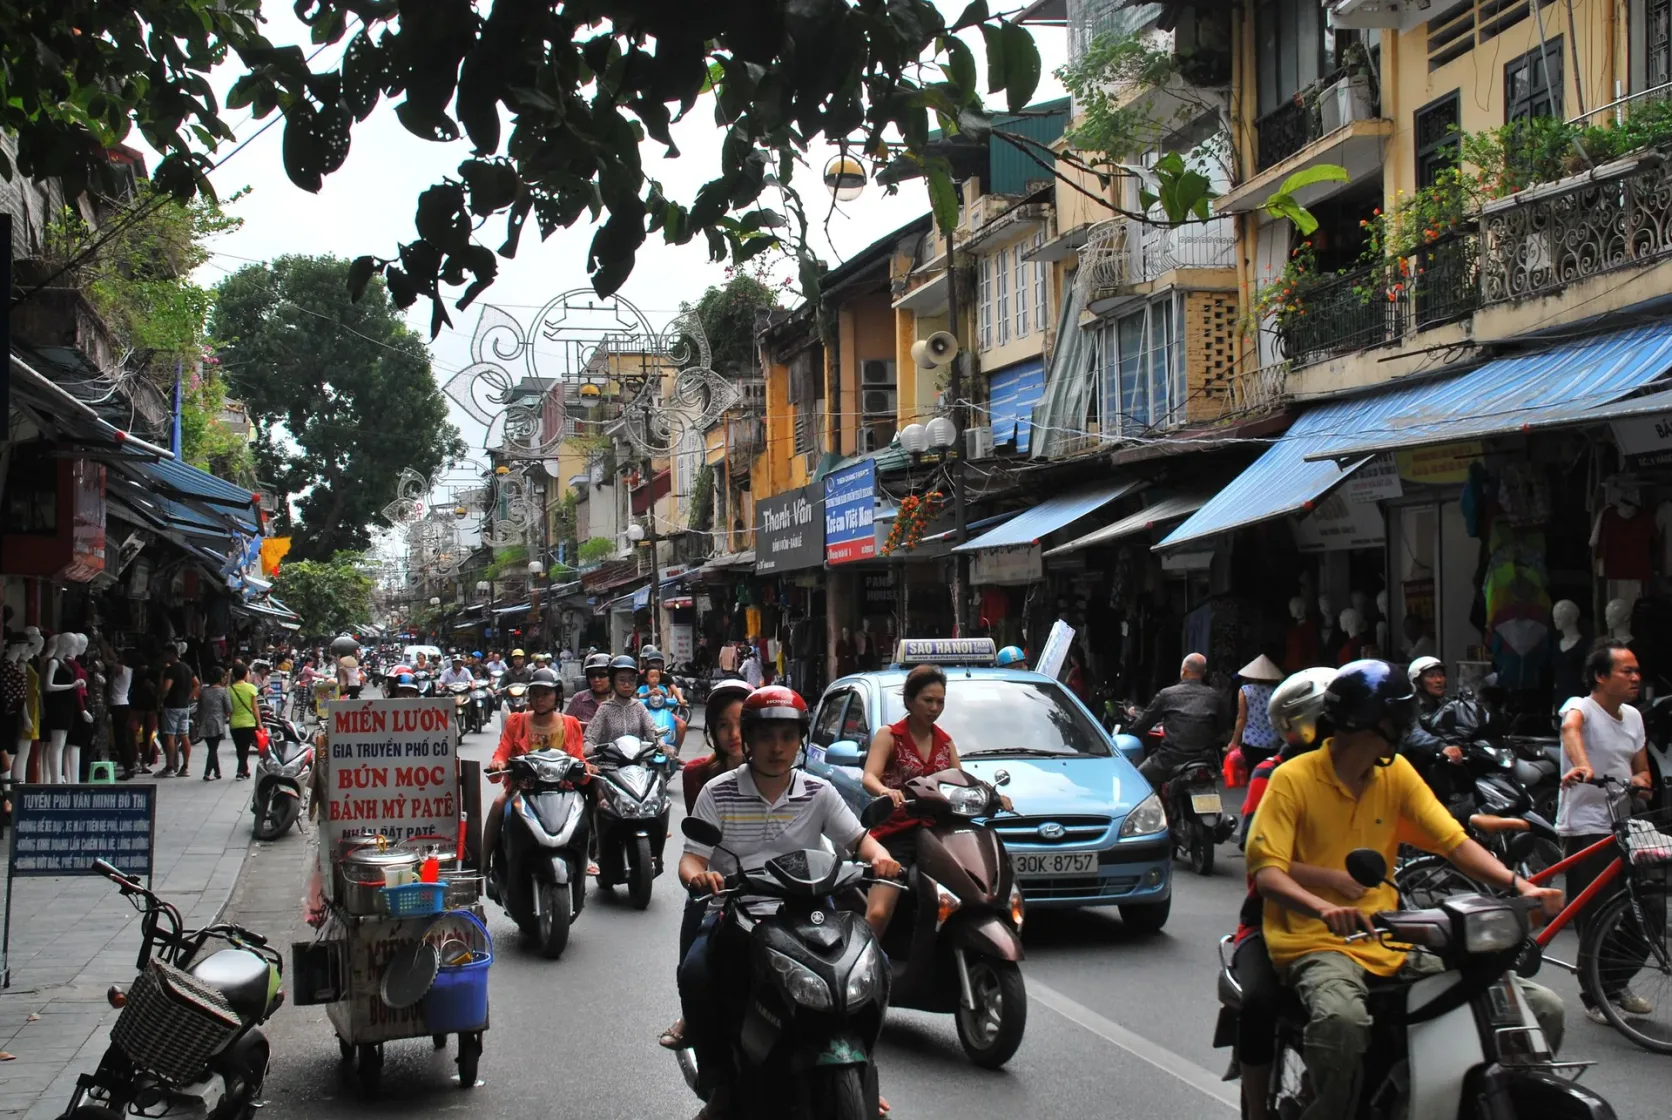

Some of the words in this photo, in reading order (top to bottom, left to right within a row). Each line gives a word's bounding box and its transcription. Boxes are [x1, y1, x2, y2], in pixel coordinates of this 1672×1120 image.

[763, 504, 790, 533] Thanh
[793, 498, 812, 525] Vân
[845, 508, 857, 534] Việt
[909, 642, 932, 654] SAO
[335, 701, 386, 733] MIẾN
[392, 707, 449, 731] LƯƠN
[333, 744, 354, 758] GIA
[356, 738, 401, 757] TRUYỀN
[405, 737, 429, 757] PHỐ
[433, 736, 448, 756] CỔ
[338, 764, 388, 789] BÚN
[395, 766, 445, 791] MỌC
[53, 791, 70, 808] PHỐ
[330, 794, 377, 821] BÁNH
[411, 791, 454, 818] PATÊ
[407, 824, 436, 838] PATÊ
